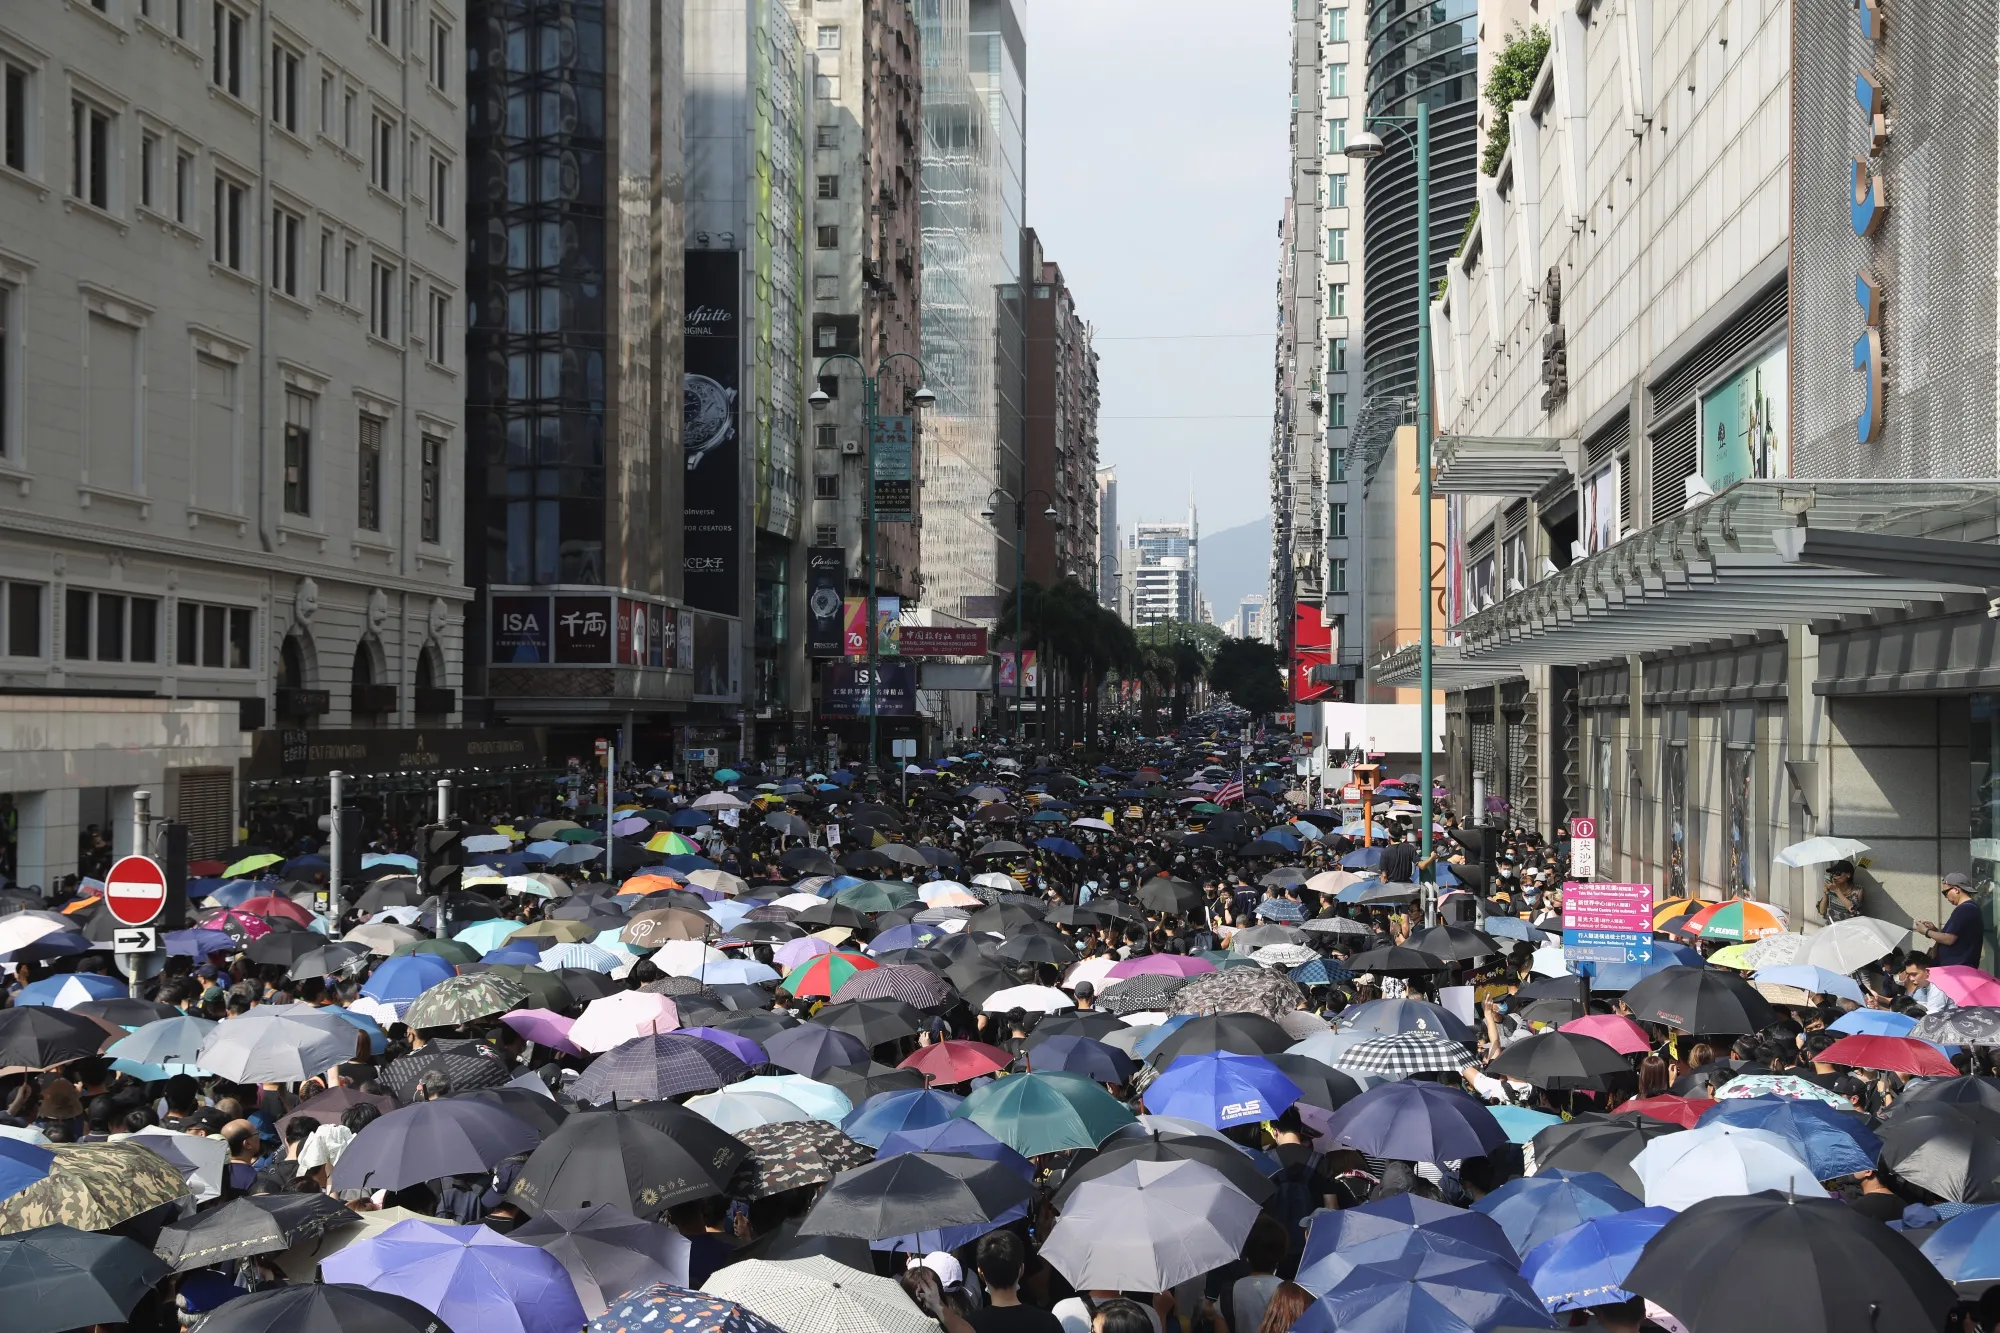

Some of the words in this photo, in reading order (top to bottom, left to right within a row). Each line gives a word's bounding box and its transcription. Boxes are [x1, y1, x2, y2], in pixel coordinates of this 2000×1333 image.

[503, 614, 539, 631] ISA
[848, 633, 862, 646] 70
[1580, 840, 1591, 875] 尖沙咀
[1221, 1100, 1260, 1116] ASUS
[659, 1178, 686, 1193] 金沙会
